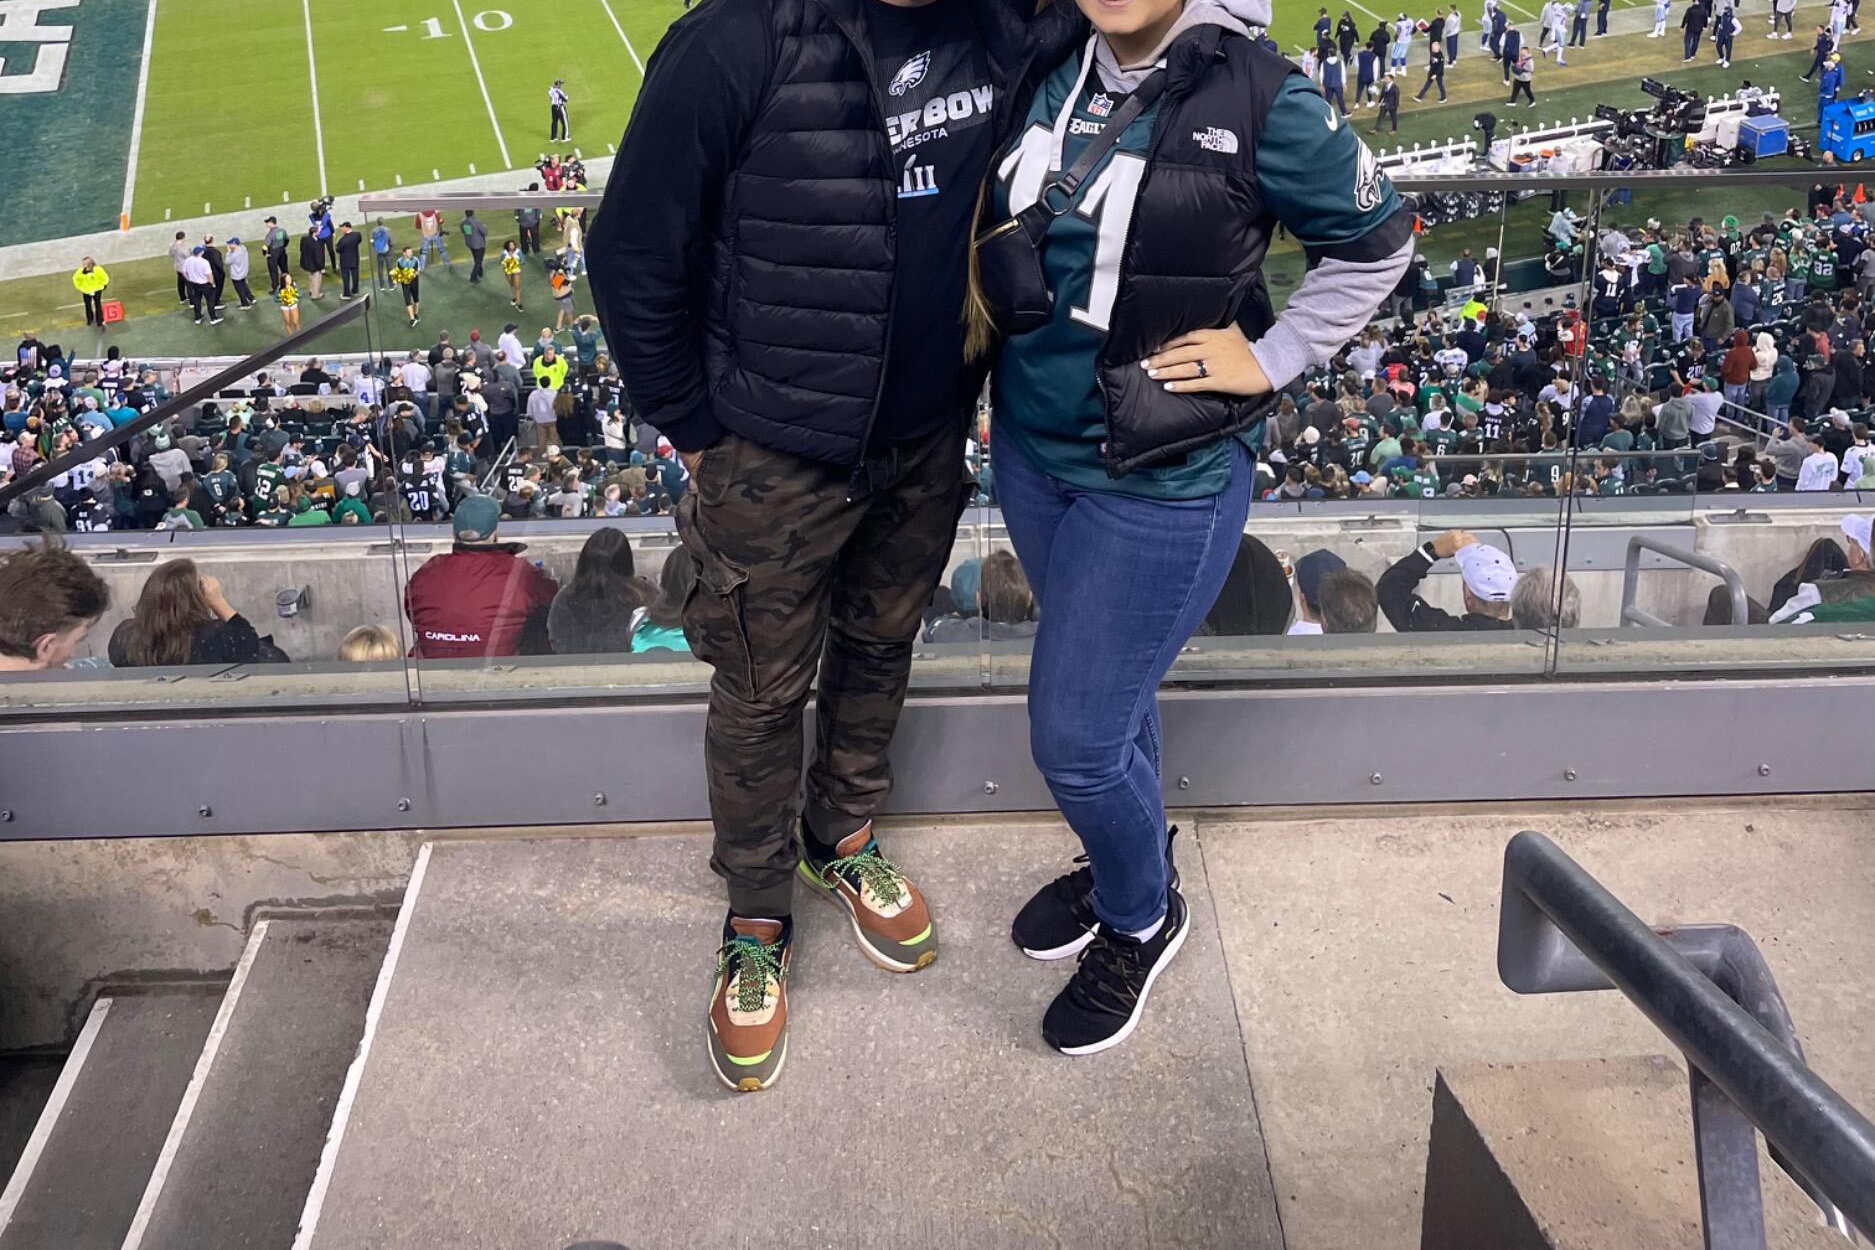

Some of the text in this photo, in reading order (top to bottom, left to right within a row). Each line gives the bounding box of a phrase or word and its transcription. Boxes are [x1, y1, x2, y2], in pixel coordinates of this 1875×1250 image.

[420, 10, 514, 40] 10
[1192, 131, 1222, 144] NORTH
[1206, 126, 1224, 136] THE
[1200, 140, 1223, 151] FACE
[1604, 283, 1617, 297] 11
[360, 391, 370, 404] 4
[1484, 423, 1500, 440] 11
[1550, 464, 1560, 484] 9
[407, 491, 430, 512] 20
[424, 631, 481, 643] CAROLINA
